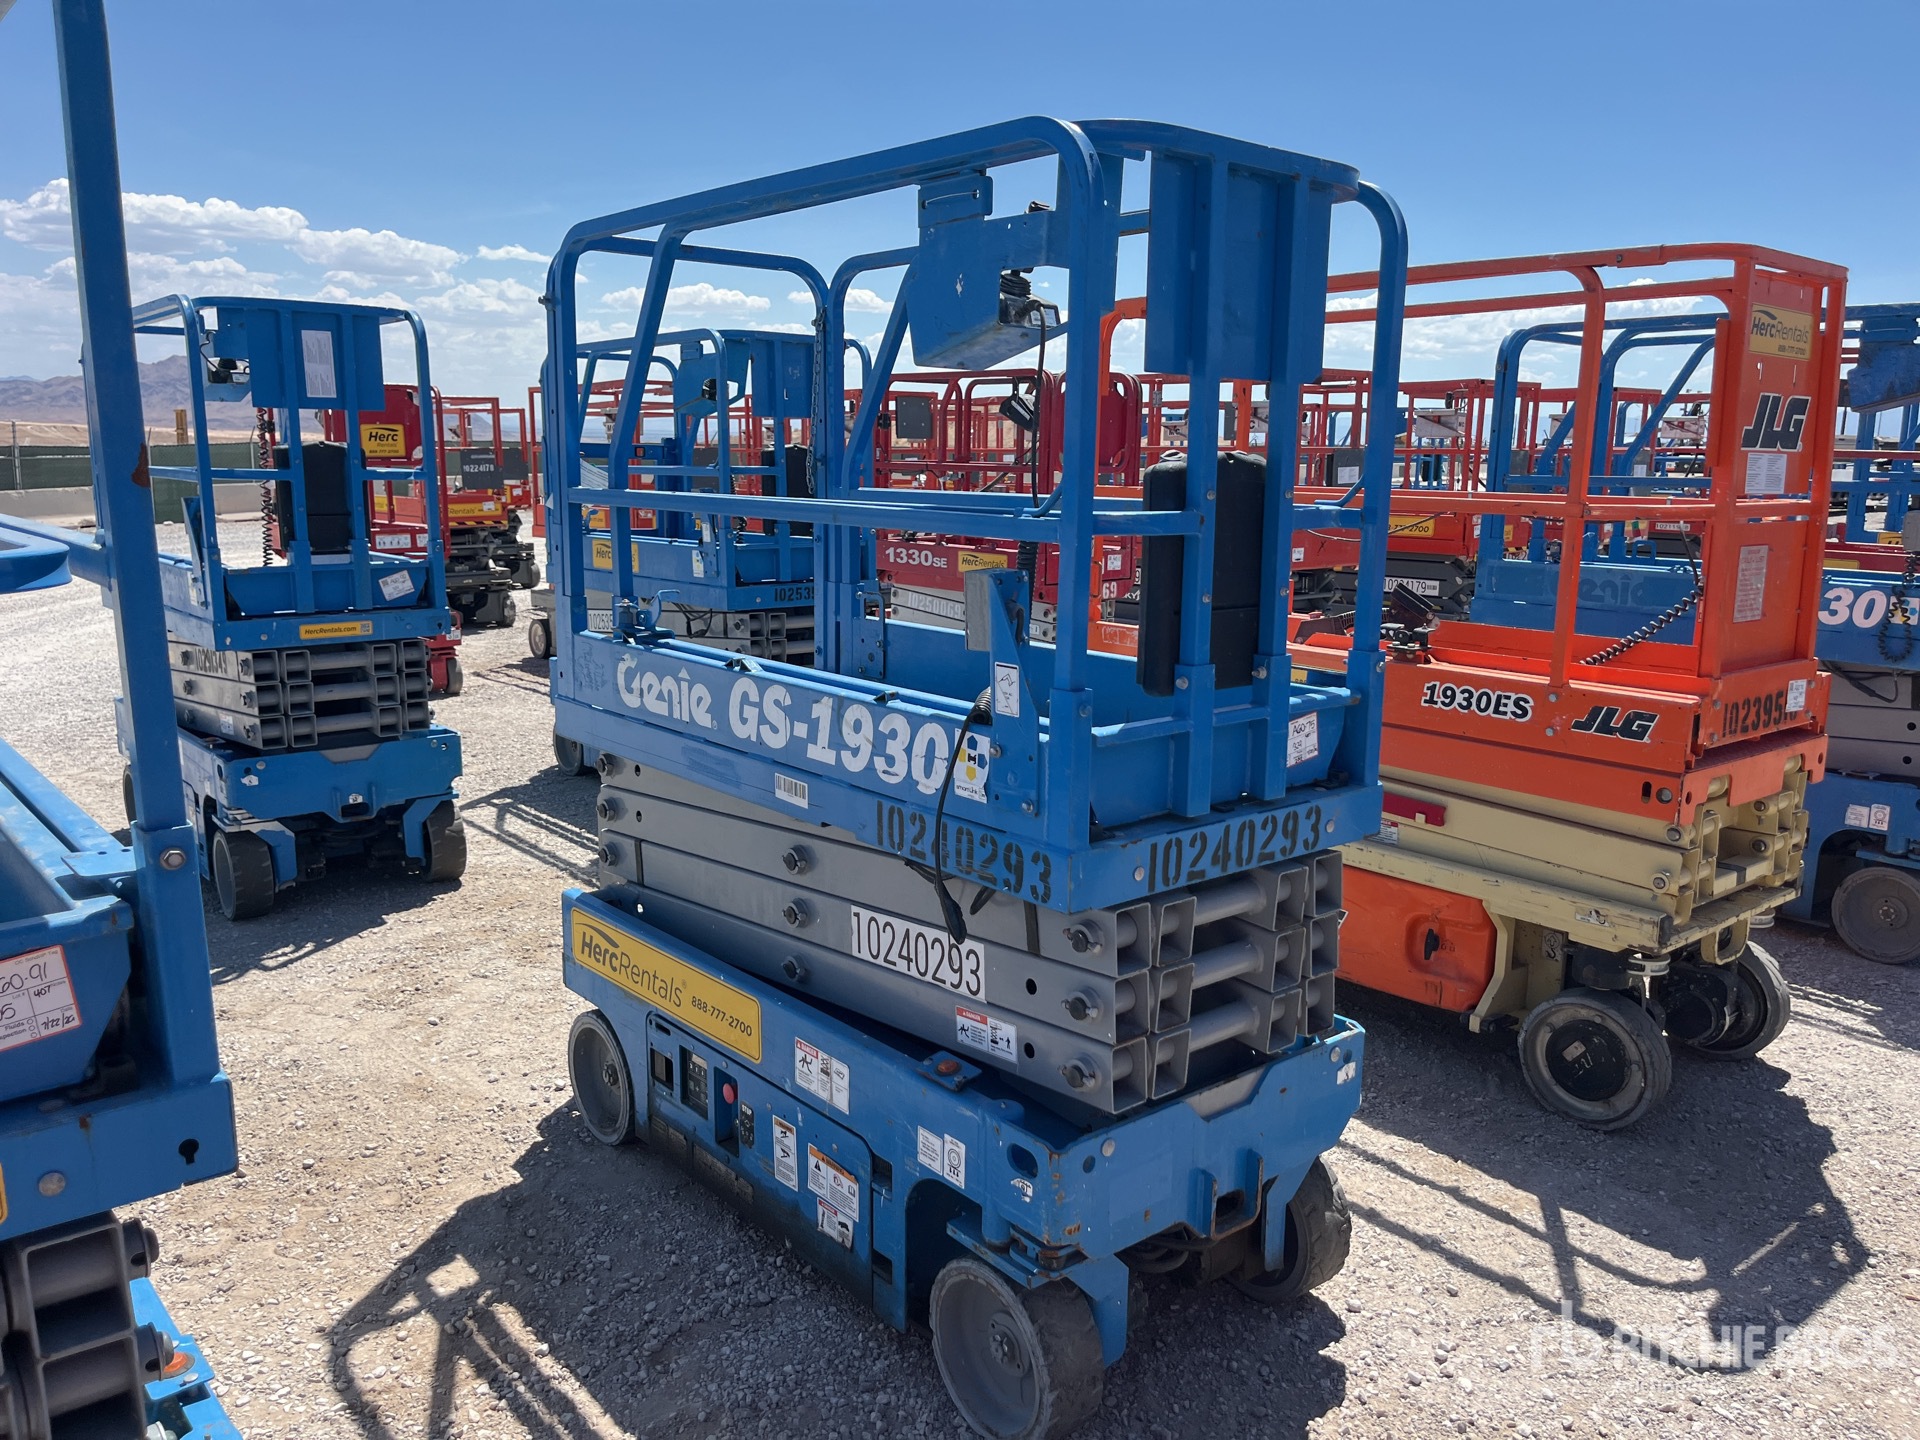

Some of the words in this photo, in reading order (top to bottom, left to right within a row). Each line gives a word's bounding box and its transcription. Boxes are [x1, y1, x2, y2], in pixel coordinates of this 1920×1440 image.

[1751, 317, 1809, 343] HercRentals
[369, 431, 399, 442] Herc
[1741, 392, 1811, 451] JLG
[304, 625, 357, 635] HercRentals.com
[617, 653, 714, 730] Genie
[729, 677, 949, 795] GS-1930
[1422, 681, 1534, 722] 1930ES
[1570, 704, 1659, 743] JLG
[1147, 804, 1322, 893] 10240293
[853, 911, 981, 996] 10240293
[580, 930, 683, 1008] HercRentals
[691, 995, 753, 1037] 888-777-2700
[5, 1022, 25, 1031] Fluids
[741, 1104, 752, 1116] STOP
